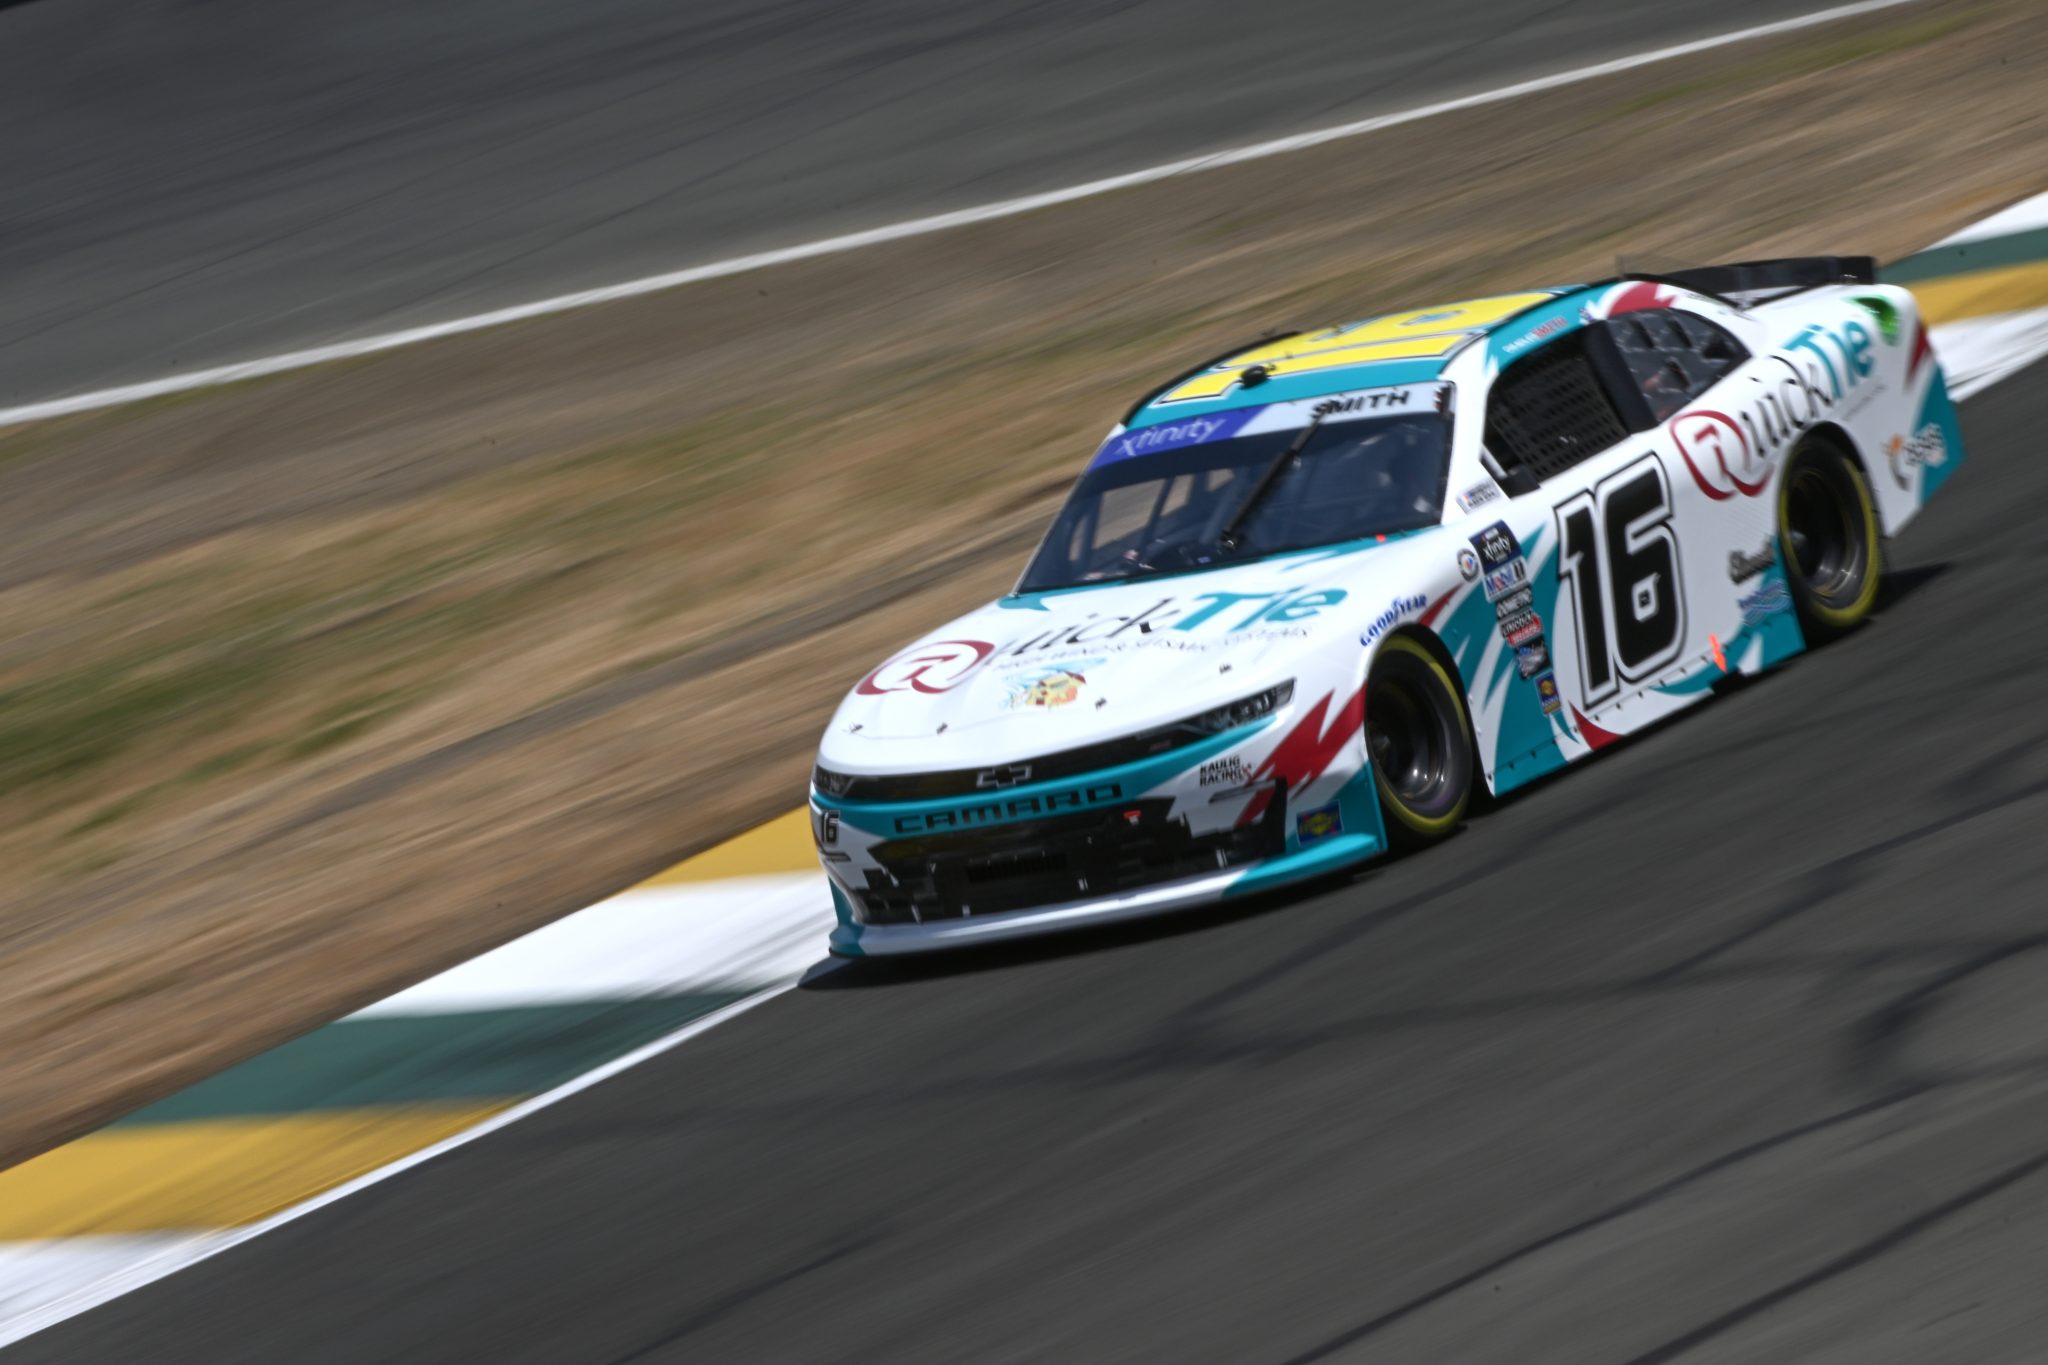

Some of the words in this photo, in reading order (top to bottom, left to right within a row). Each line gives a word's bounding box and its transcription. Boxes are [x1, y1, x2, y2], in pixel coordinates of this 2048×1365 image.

[1310, 387, 1412, 421] SMITH
[1113, 416, 1227, 458] xfinity
[1553, 450, 1689, 708] 16
[1360, 593, 1427, 647] GOODYEAR
[1199, 754, 1241, 774] KAULIG
[1199, 767, 1245, 787] RACING
[894, 783, 1123, 835] CAMARO
